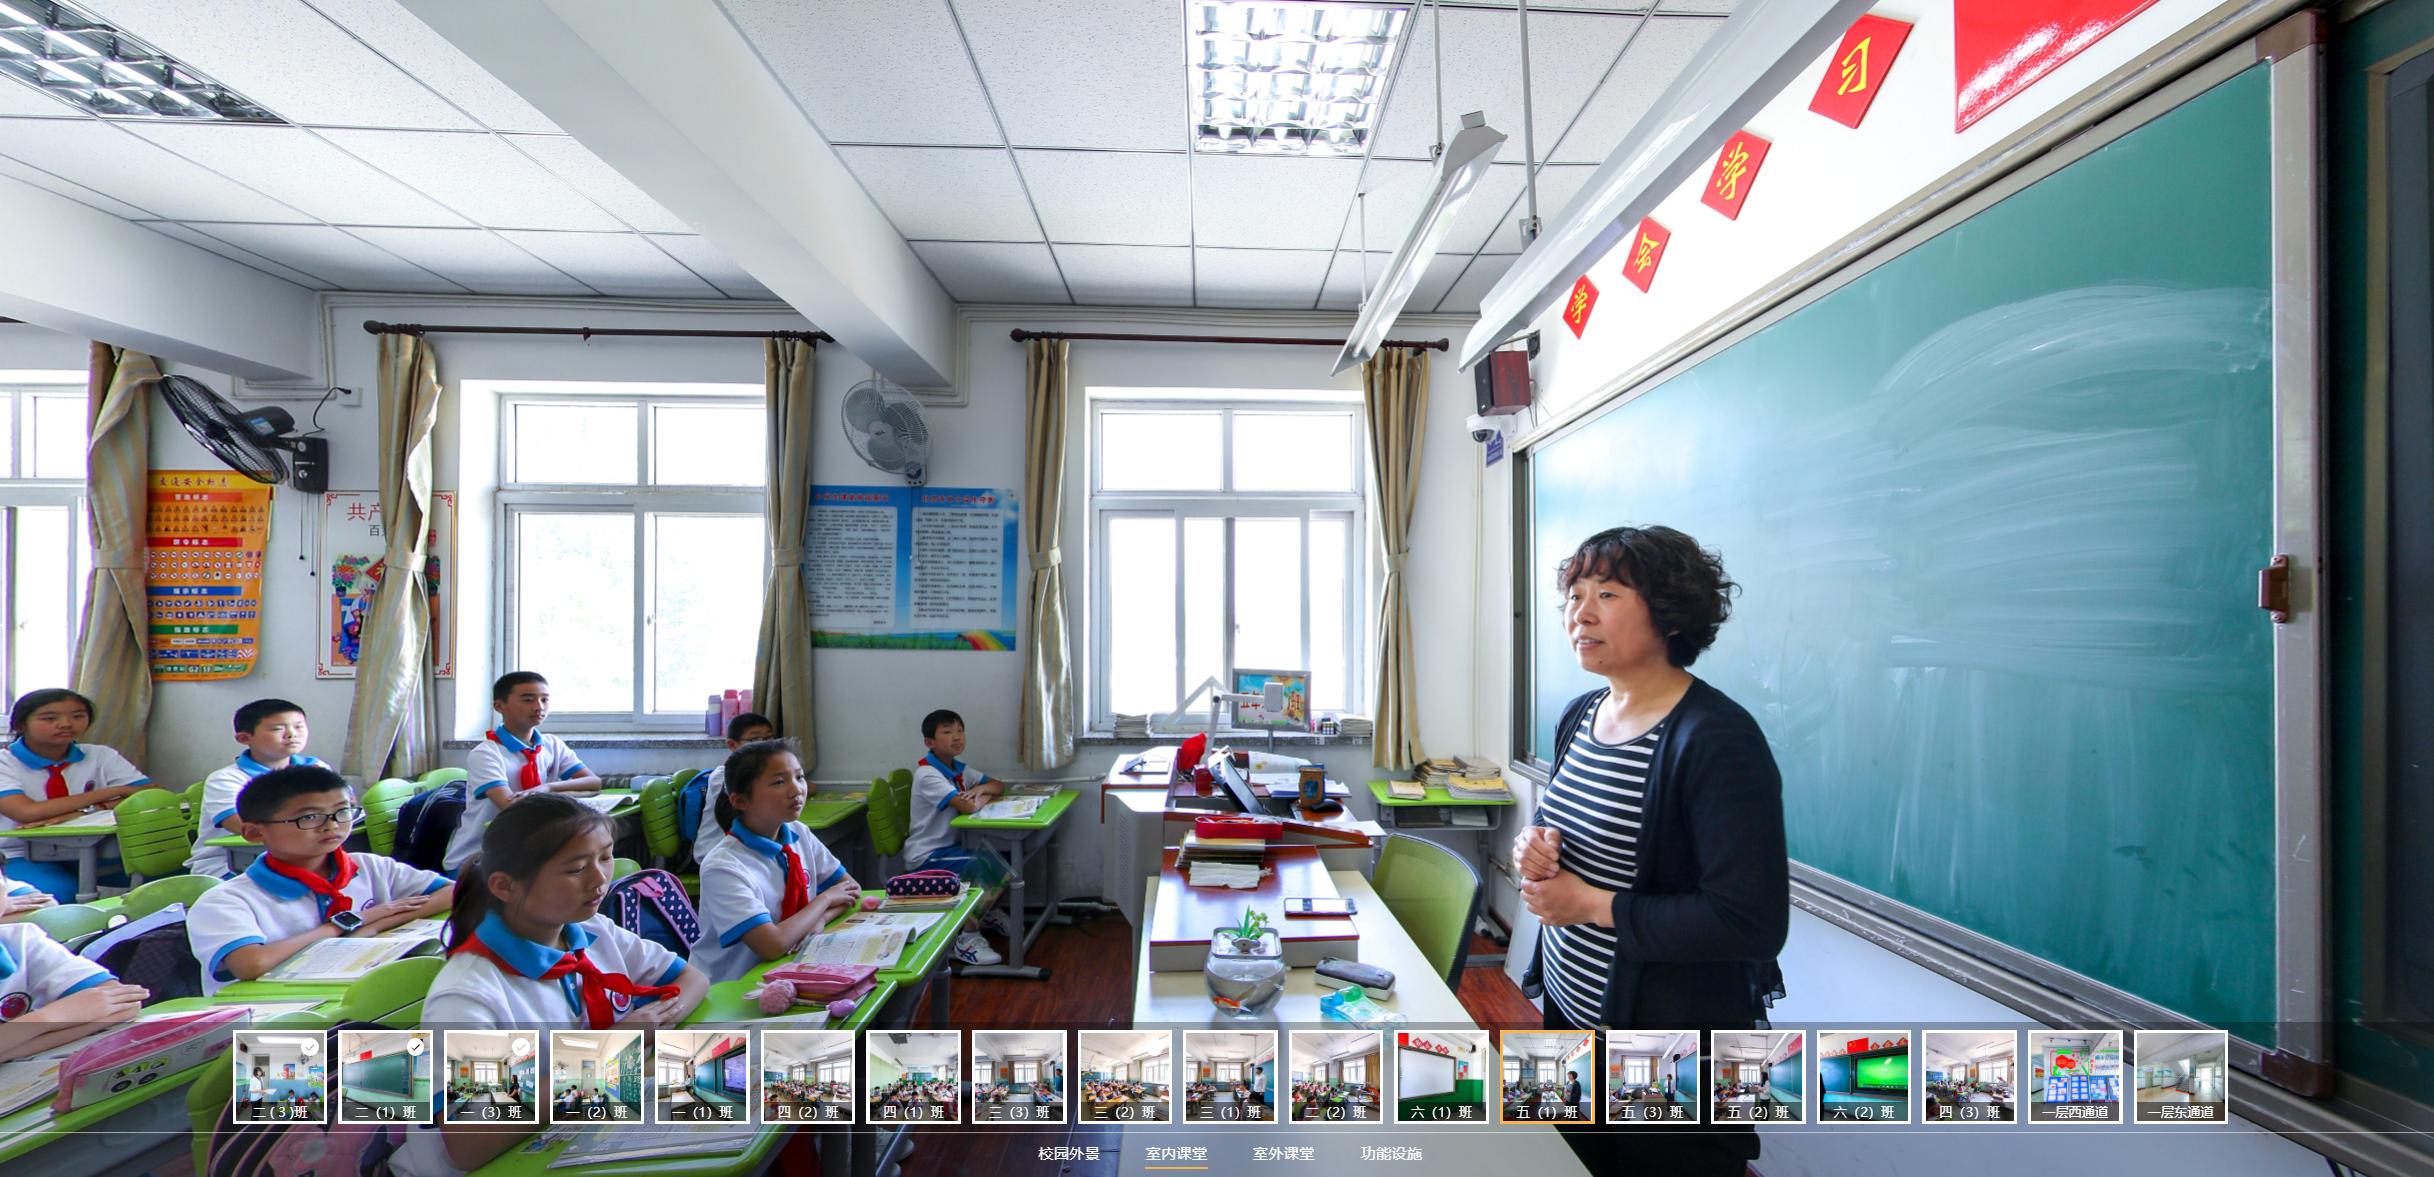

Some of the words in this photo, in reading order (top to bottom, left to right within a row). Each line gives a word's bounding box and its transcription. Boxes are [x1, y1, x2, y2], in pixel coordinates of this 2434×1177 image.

[1633, 233, 1660, 273] 会
[1716, 141, 1750, 200] 学
[1837, 37, 1872, 96] 习
